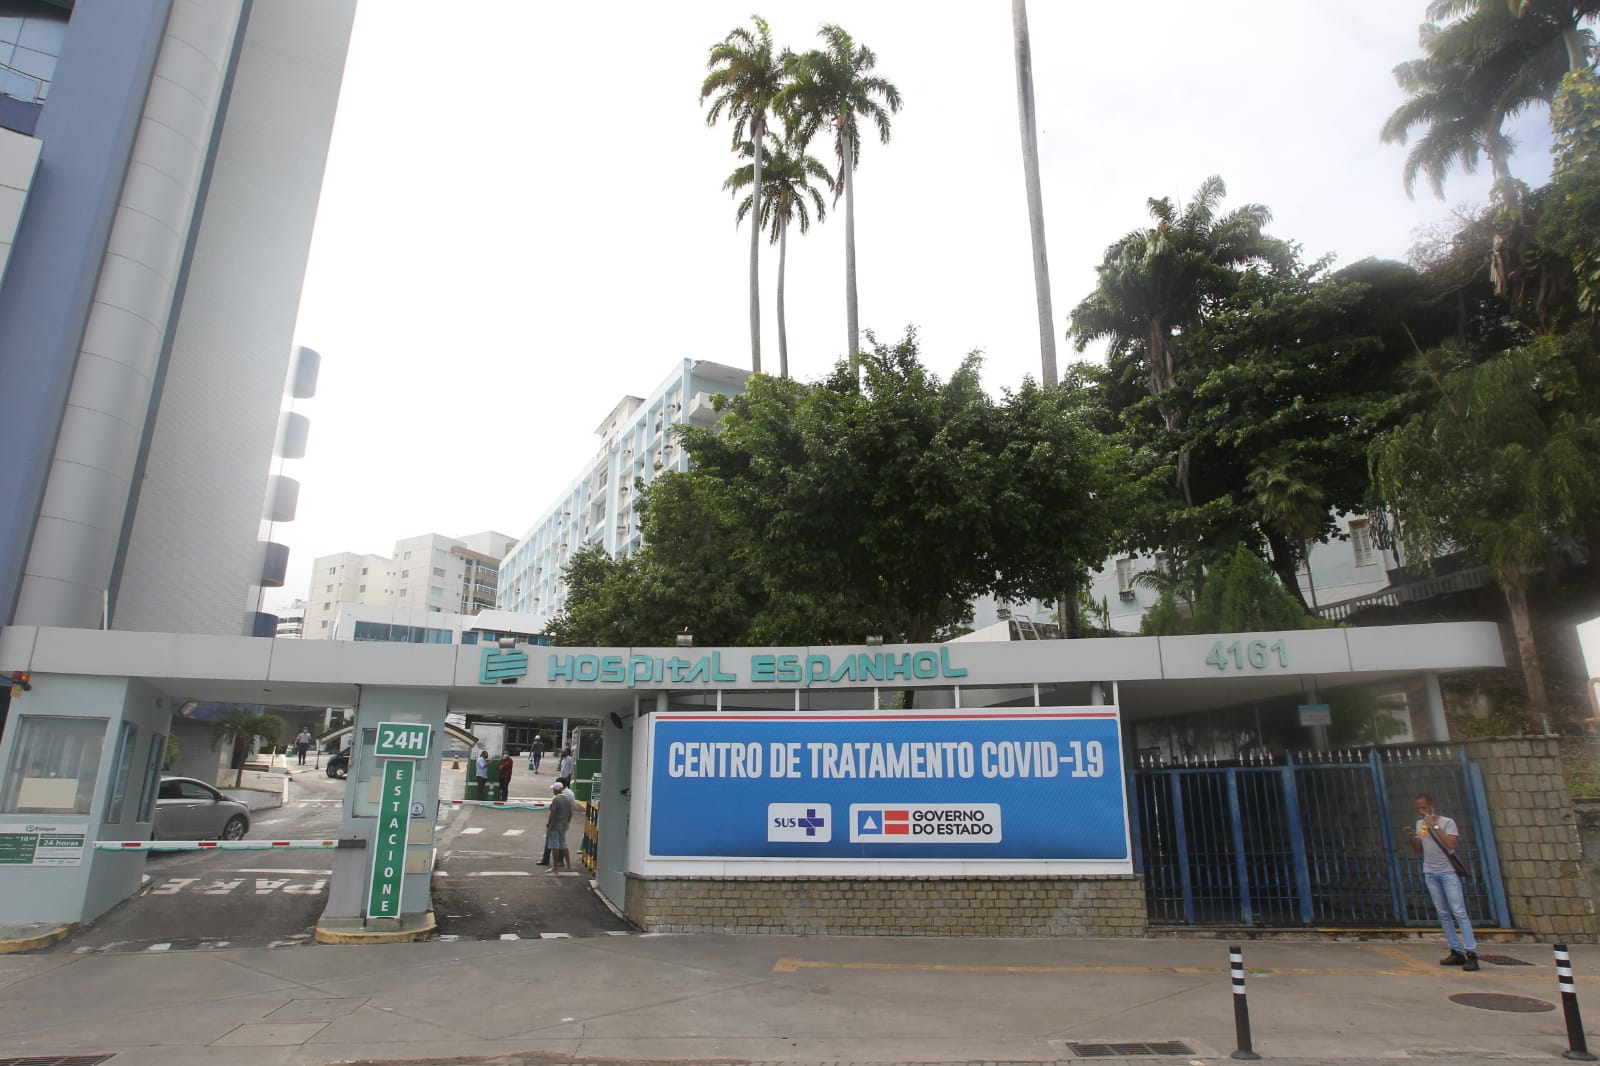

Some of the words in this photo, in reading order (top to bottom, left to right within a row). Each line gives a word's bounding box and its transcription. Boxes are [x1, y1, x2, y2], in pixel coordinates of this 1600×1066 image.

[1206, 639, 1289, 671] 4161
[381, 730, 424, 750] 24H
[668, 741, 763, 779] CENTRO
[769, 742, 802, 779] DE
[807, 741, 975, 779] TRATAMENTO
[981, 740, 1105, 779] COVID-19
[774, 817, 796, 828] SUS
[912, 810, 985, 822] GOVERNO
[912, 823, 935, 835] DO
[936, 823, 994, 835] ESTADO
[381, 769, 404, 912] ESTACIONE
[150, 877, 328, 896] PARE
